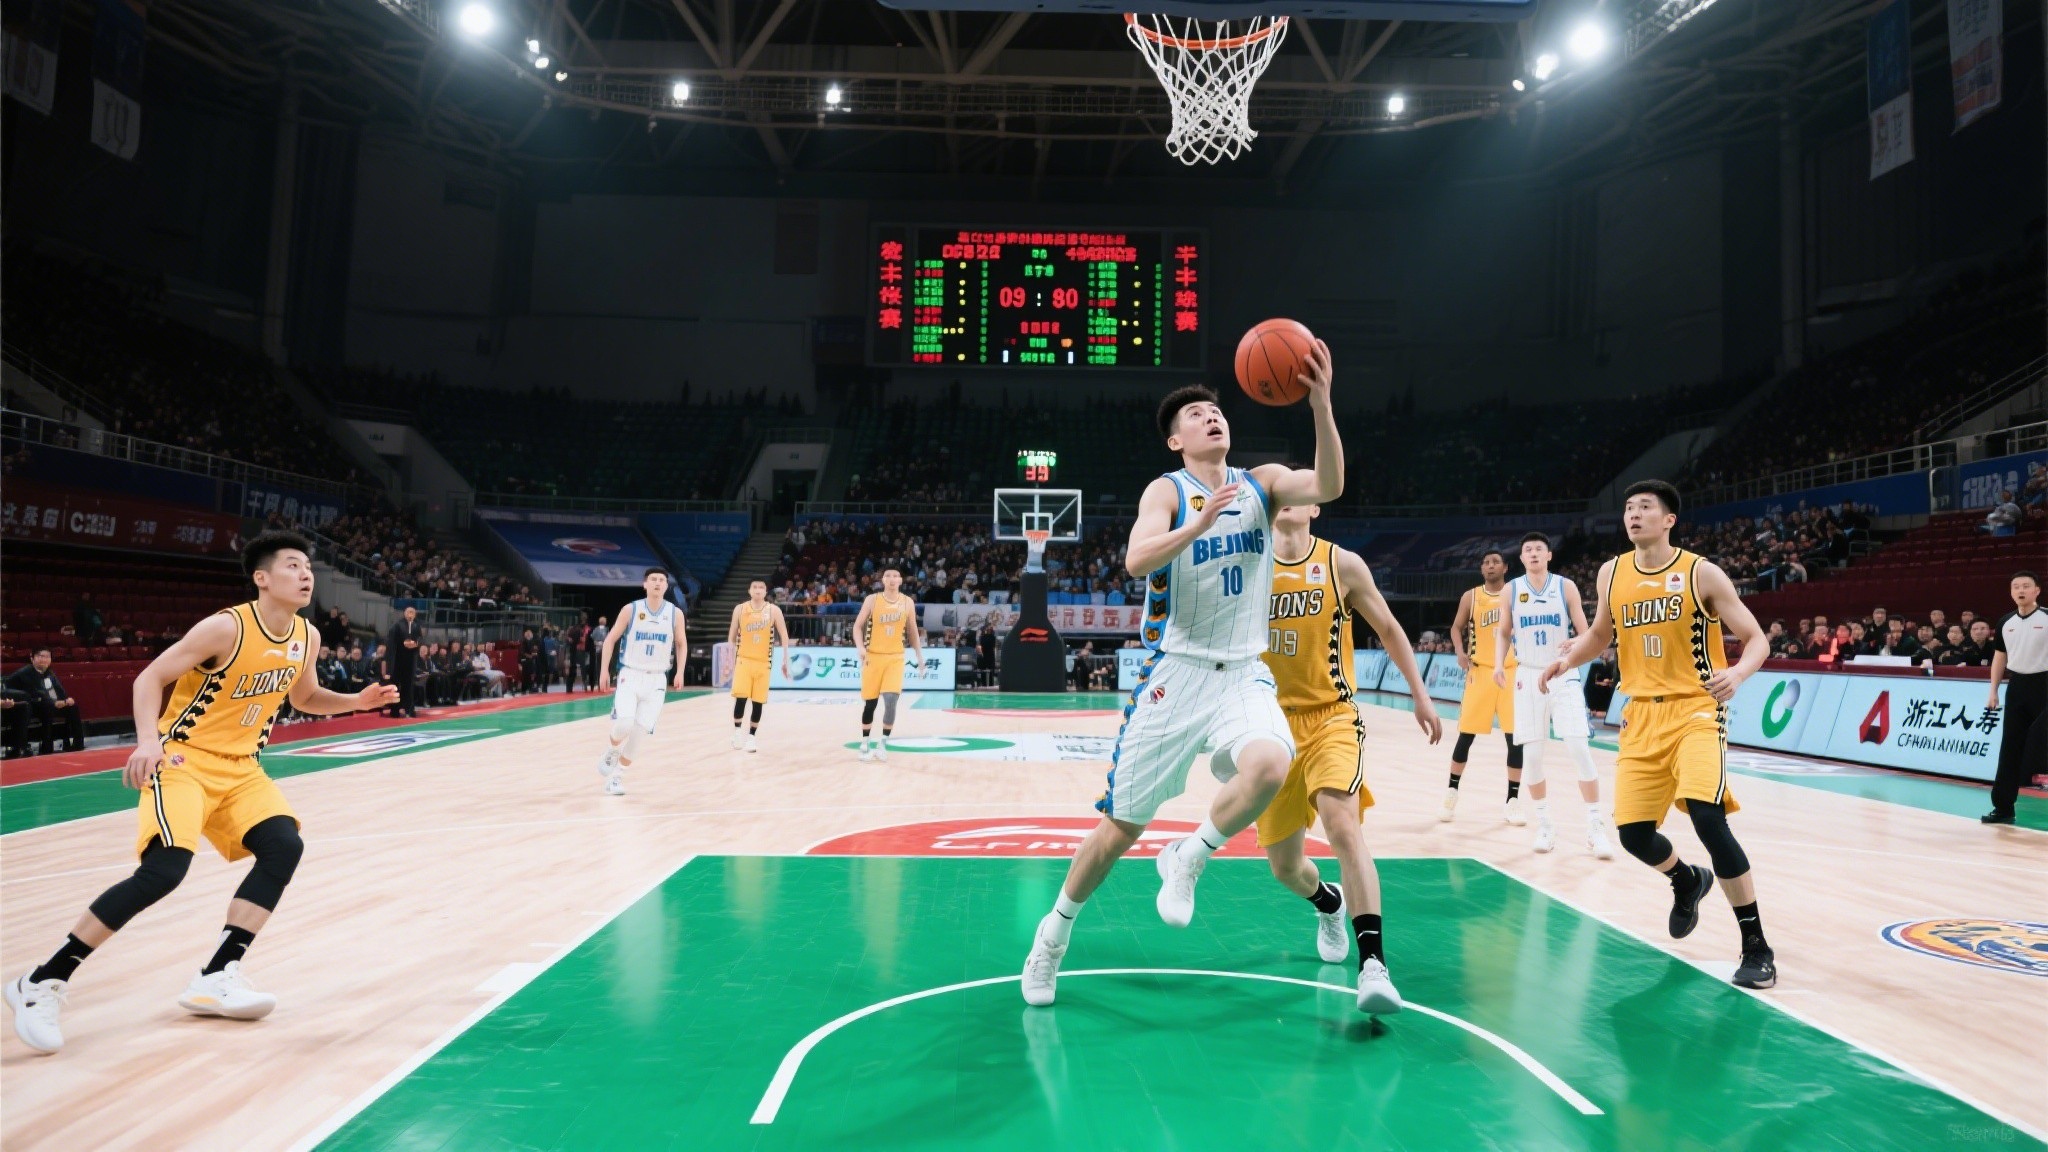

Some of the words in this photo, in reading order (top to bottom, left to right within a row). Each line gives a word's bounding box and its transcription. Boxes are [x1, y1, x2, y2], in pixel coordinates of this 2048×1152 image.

[999, 286, 1026, 308] 09
[1192, 528, 1265, 566] BEJING
[1220, 565, 1244, 597] 10
[1269, 588, 1325, 621] IONS
[1621, 594, 1684, 629] LIONS
[1641, 633, 1663, 659] 10
[230, 665, 297, 700] LIONS
[1902, 698, 2004, 736] 浙江人寿
